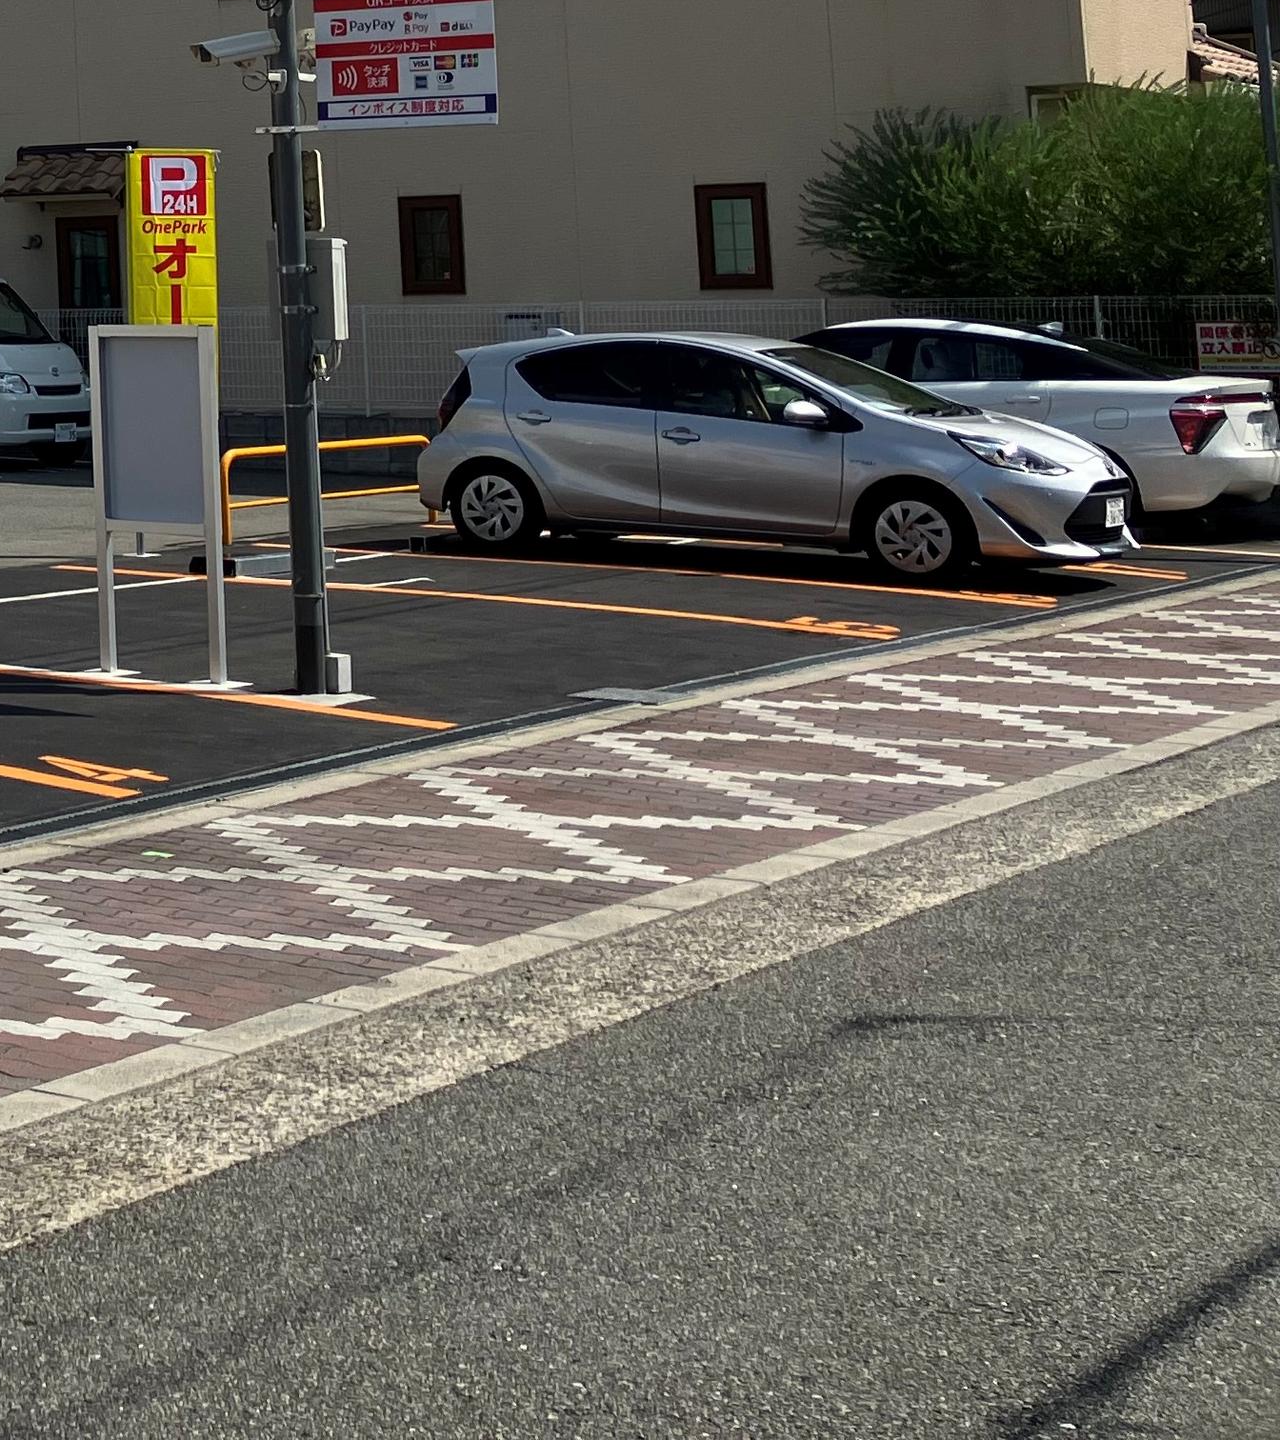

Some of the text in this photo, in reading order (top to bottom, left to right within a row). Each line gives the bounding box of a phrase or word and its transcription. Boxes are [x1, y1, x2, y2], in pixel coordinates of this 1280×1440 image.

[349, 19, 396, 34] PayPay
[369, 39, 438, 54] クレジットカード
[363, 64, 391, 76] タッチ
[412, 60, 429, 68] VISA
[367, 76, 389, 88] 決済
[348, 98, 465, 116] インボイス制度対応
[149, 157, 198, 214] P
[163, 194, 198, 214] 24H
[142, 219, 208, 235] OnePark
[37, 755, 170, 782] 4
